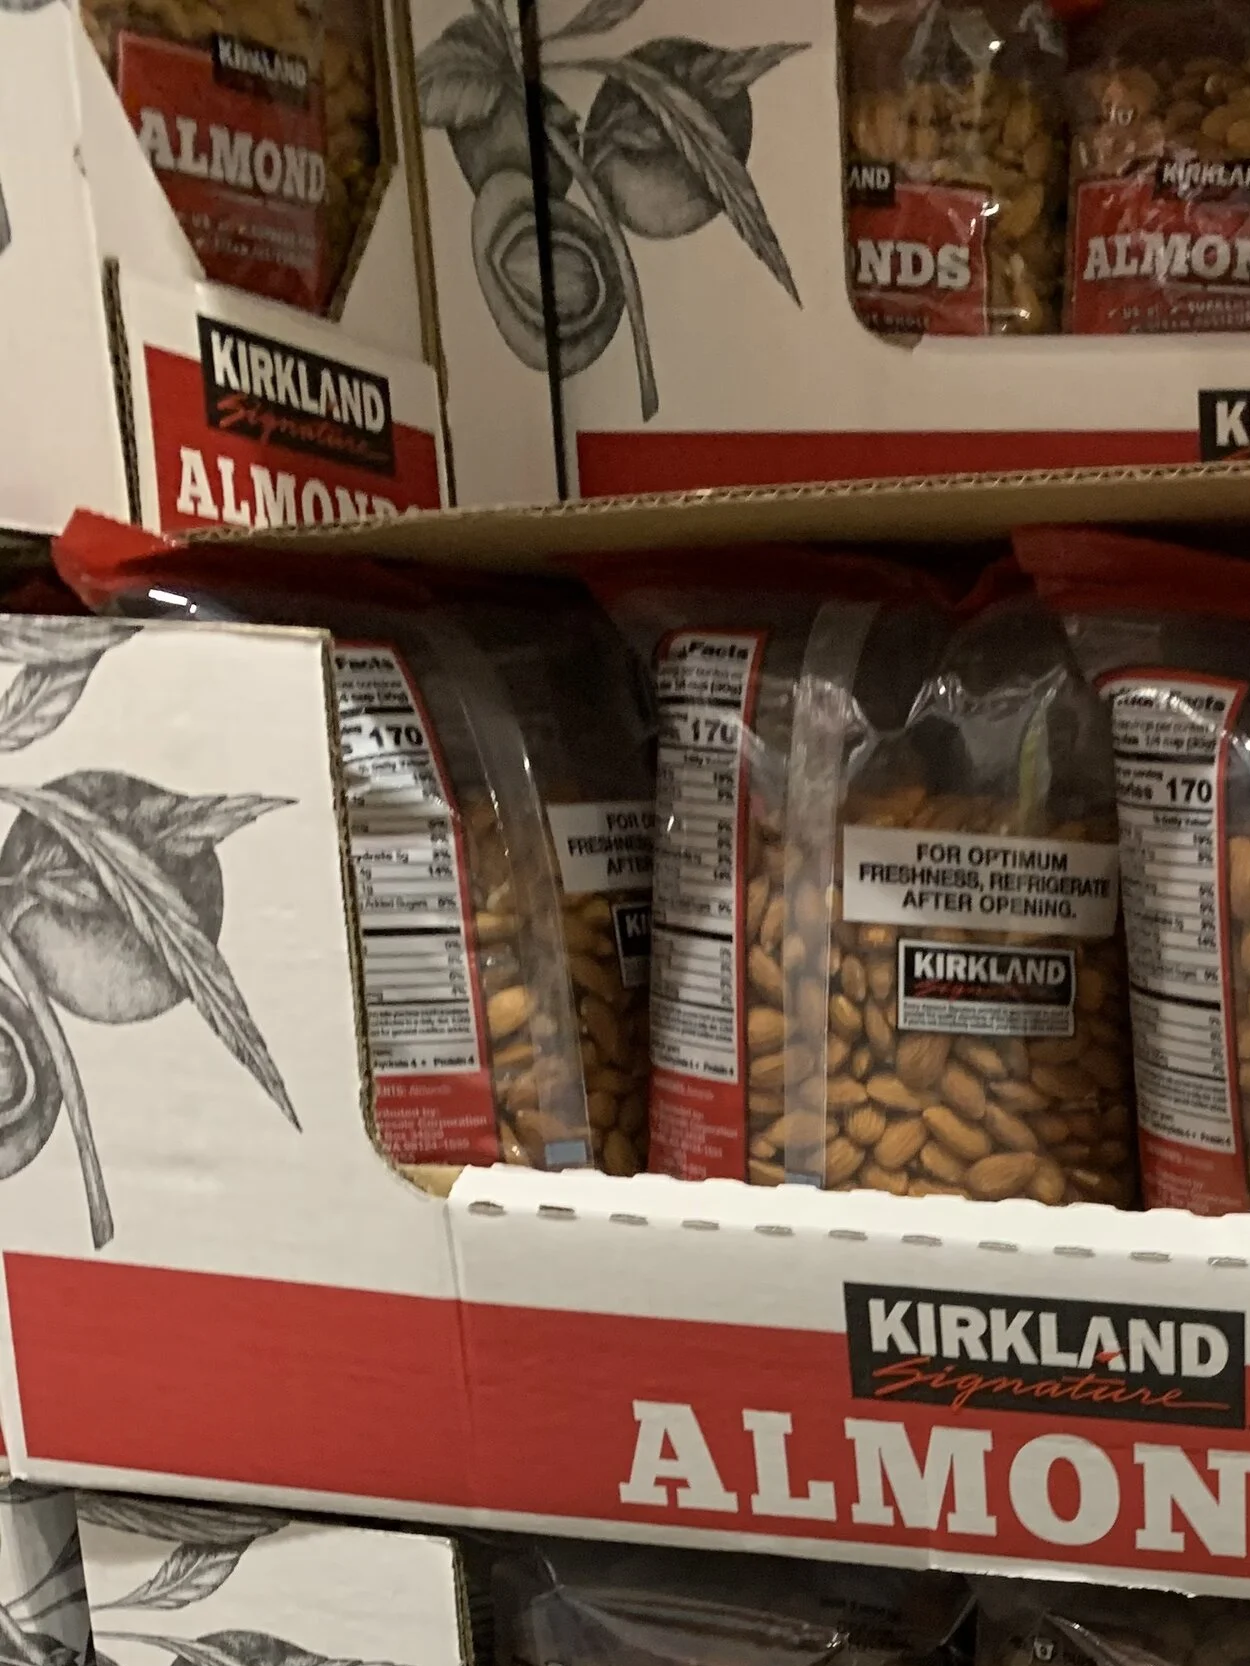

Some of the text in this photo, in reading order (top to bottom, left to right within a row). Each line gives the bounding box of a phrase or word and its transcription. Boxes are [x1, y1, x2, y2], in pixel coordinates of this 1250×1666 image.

[852, 238, 971, 290] NDS
[211, 330, 386, 434] KIRKLAND
[176, 446, 420, 530] ALMON
[368, 726, 423, 749] 170
[1167, 778, 1212, 803] 170
[917, 844, 1067, 872] FOR OPTIMUM
[860, 863, 1111, 899] FRESHNESS, REFRIGERATE
[903, 890, 1077, 919] AFTER OPENING.
[914, 951, 1066, 985] KIRKLAND
[868, 1298, 1229, 1378] KIRKLAND
[872, 1354, 1231, 1414] Signature
